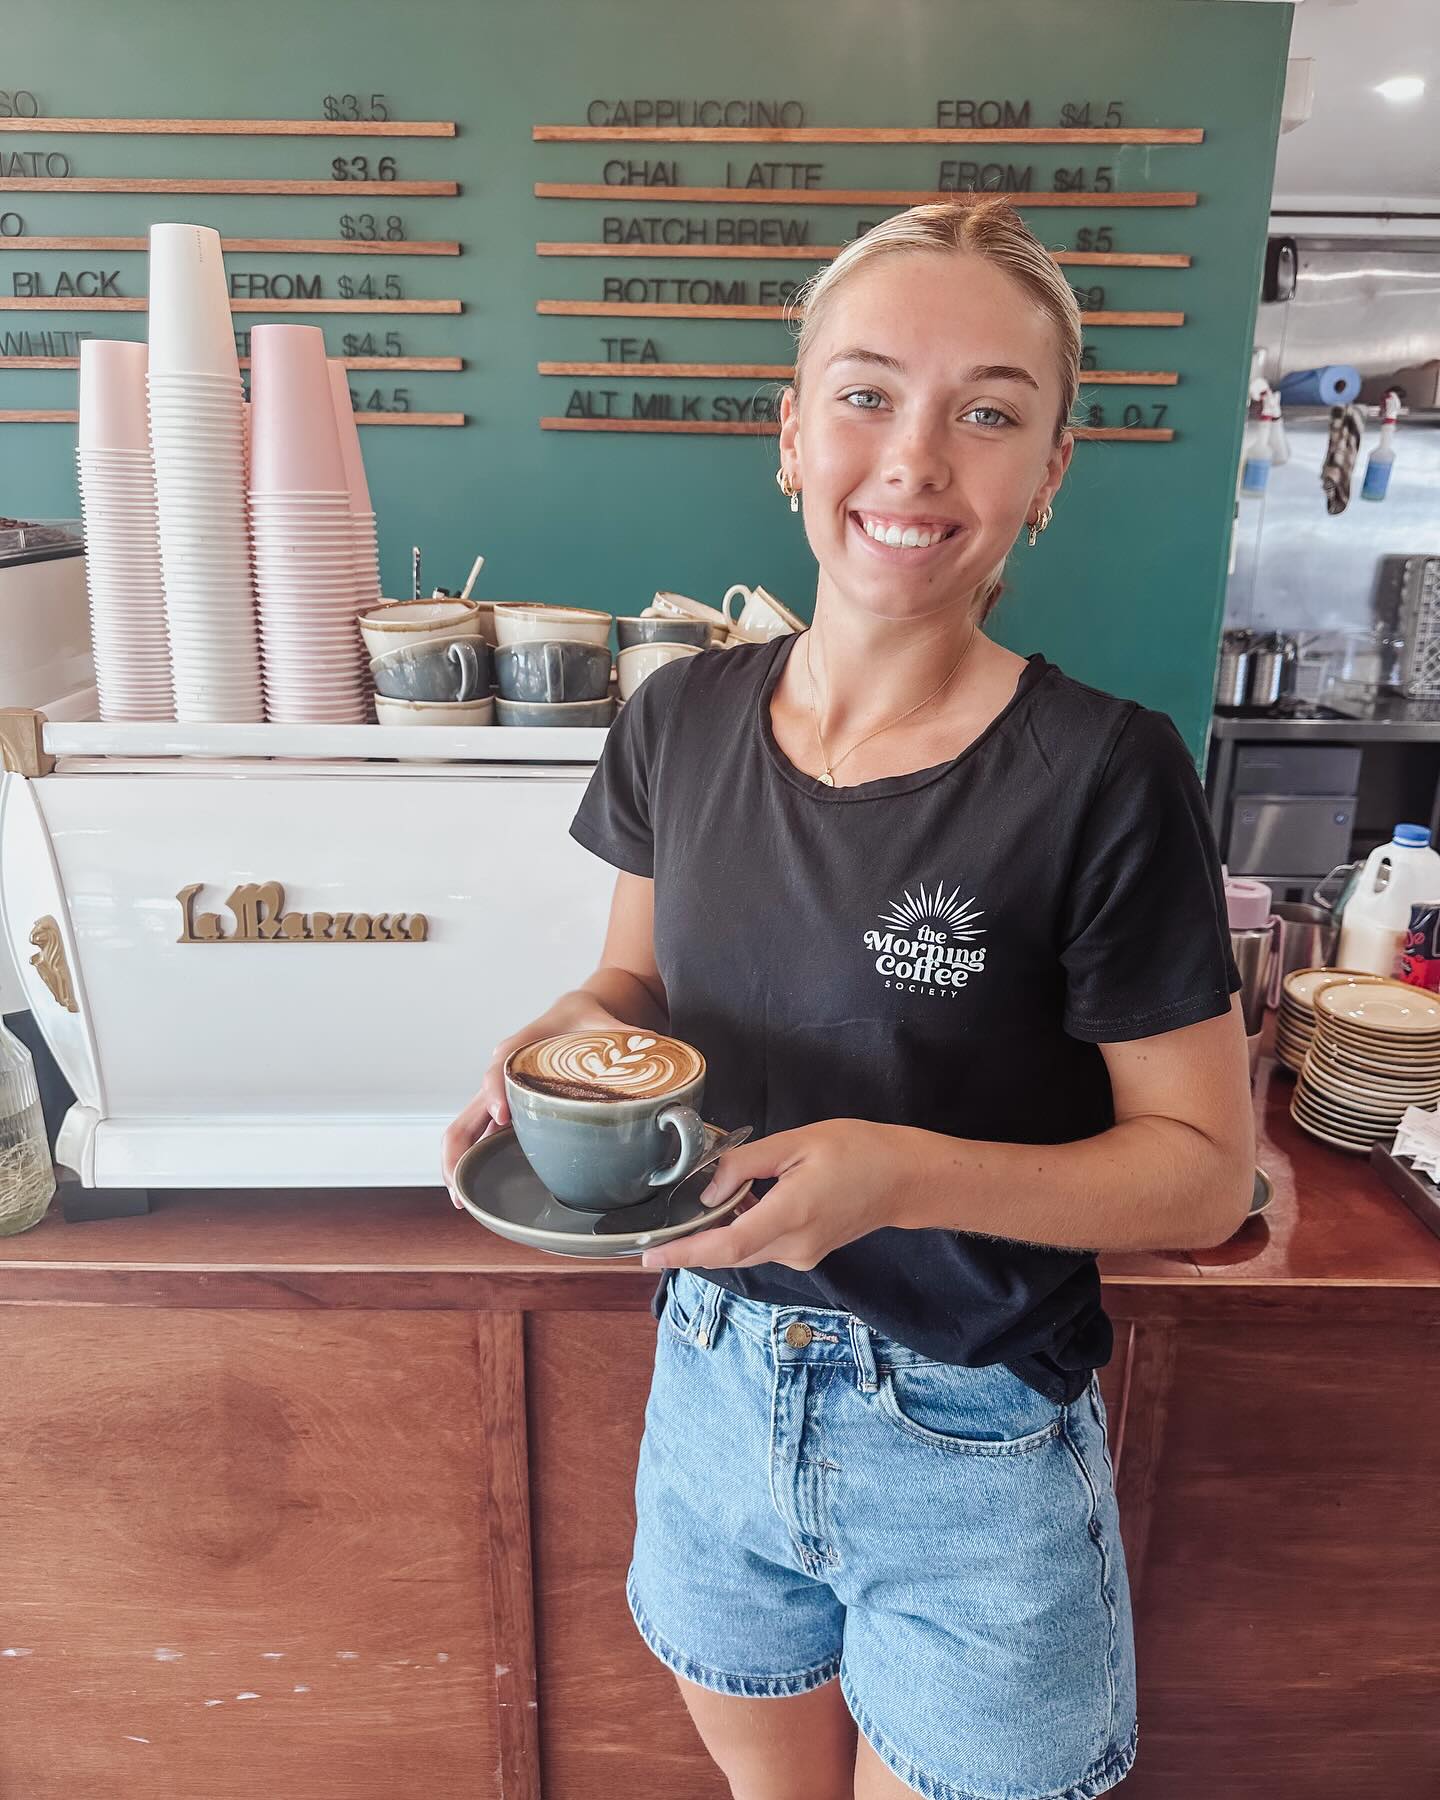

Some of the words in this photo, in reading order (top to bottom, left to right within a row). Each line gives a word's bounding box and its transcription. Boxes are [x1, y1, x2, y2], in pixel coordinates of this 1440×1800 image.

[323, 94, 389, 122] $3.5
[587, 99, 804, 128] CAPPUCCINO
[937, 101, 1031, 129] FROM
[1061, 101, 1123, 129] $4.5
[332, 156, 396, 182] $3.6
[603, 160, 681, 187] CHAI
[726, 162, 823, 189] LATTE
[938, 160, 1033, 193] FROM
[339, 214, 406, 241] $3.8
[603, 217, 707, 245] BATCH
[716, 219, 809, 246] BREW
[1077, 227, 1113, 252] $5
[13, 270, 122, 298] BLACK
[230, 273, 322, 300] FROM
[338, 274, 401, 300] $4.5
[603, 277, 812, 306] BOTTOMLES
[343, 332, 402, 358] $4.5
[601, 338, 660, 363] TEA
[565, 390, 619, 417] ALT
[633, 392, 700, 420] MILK
[176, 883, 226, 943] La
[917, 924, 948, 944] the
[863, 930, 987, 972] Morning
[875, 954, 969, 988] Coffee
[884, 980, 958, 998] SOCIETY
